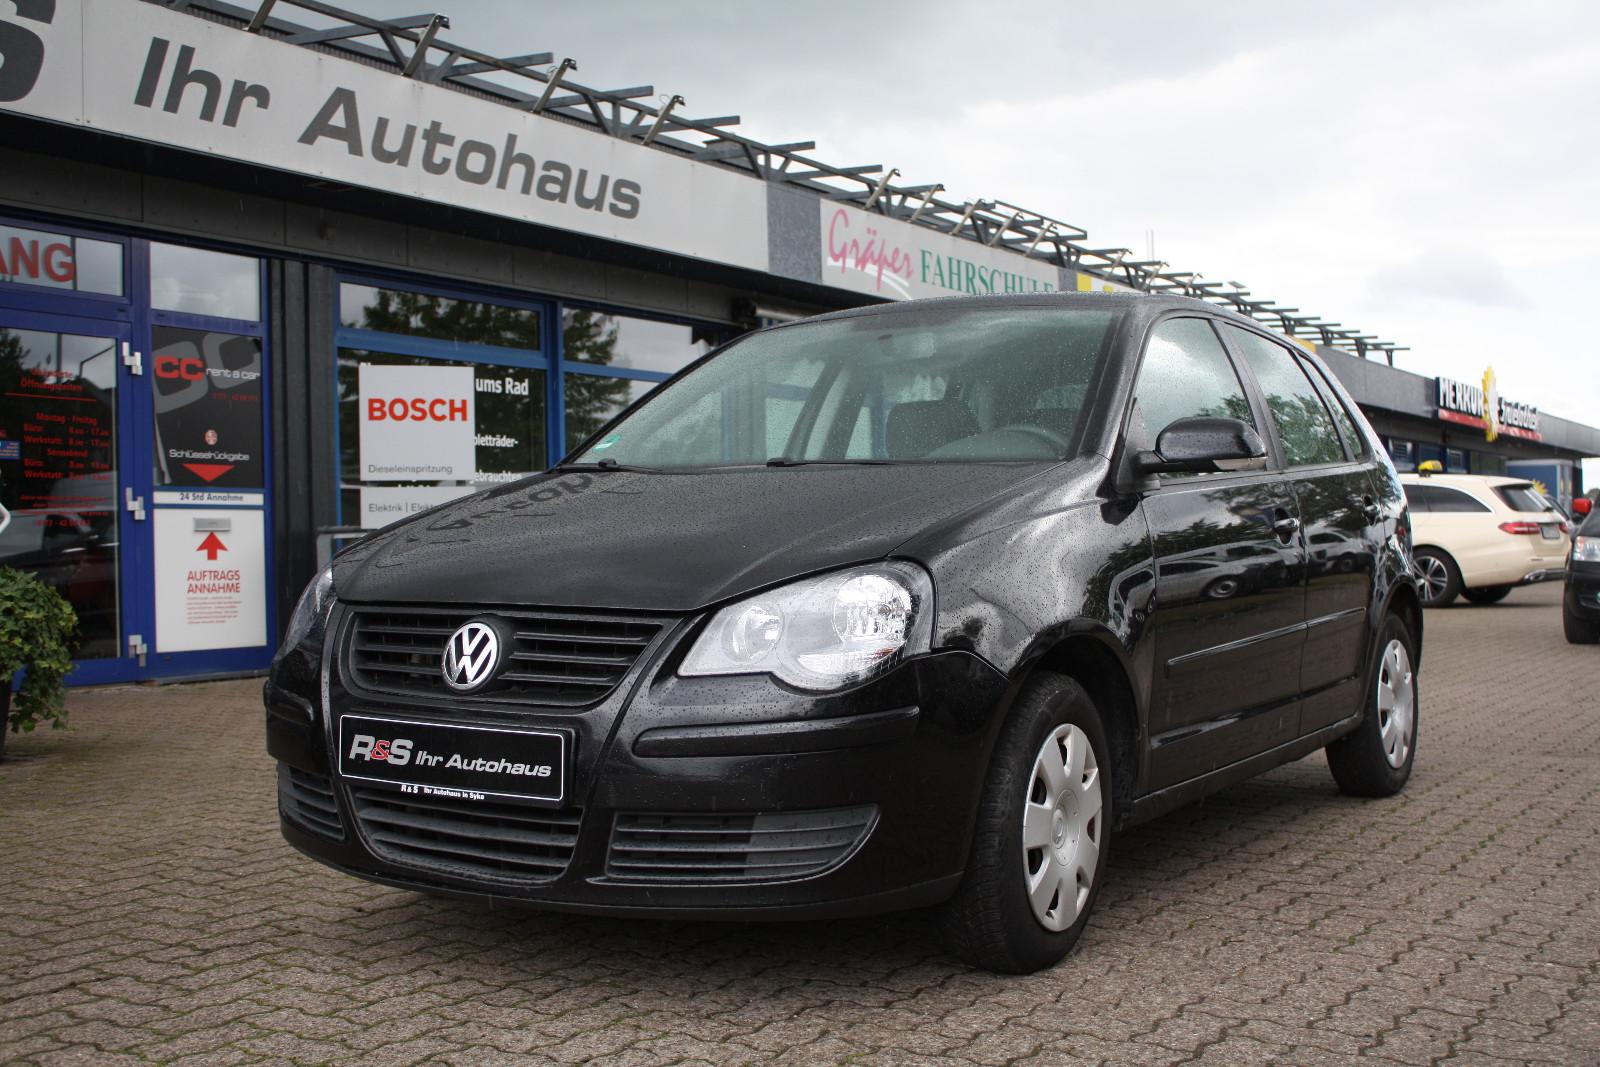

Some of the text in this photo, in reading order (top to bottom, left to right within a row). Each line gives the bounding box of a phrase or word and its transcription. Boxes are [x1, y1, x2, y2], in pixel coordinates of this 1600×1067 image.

[133, 36, 271, 128] Ihr
[297, 86, 642, 220] Autohaus
[828, 208, 914, 292] Gräper
[154, 356, 205, 381] CC
[475, 377, 529, 396] ums Rad
[1439, 377, 1485, 419] MERKUR
[367, 398, 468, 421] BOSCH
[368, 464, 453, 474] Dieseleinspritzung
[180, 492, 244, 502] 24 Std Annahme
[368, 503, 402, 513] Elektrik
[187, 569, 241, 581] AUFTRAGS
[187, 582, 241, 594] ANNAHME
[349, 734, 551, 777] R&S Ihr Autohaus
[433, 788, 461, 798] Autohaus
